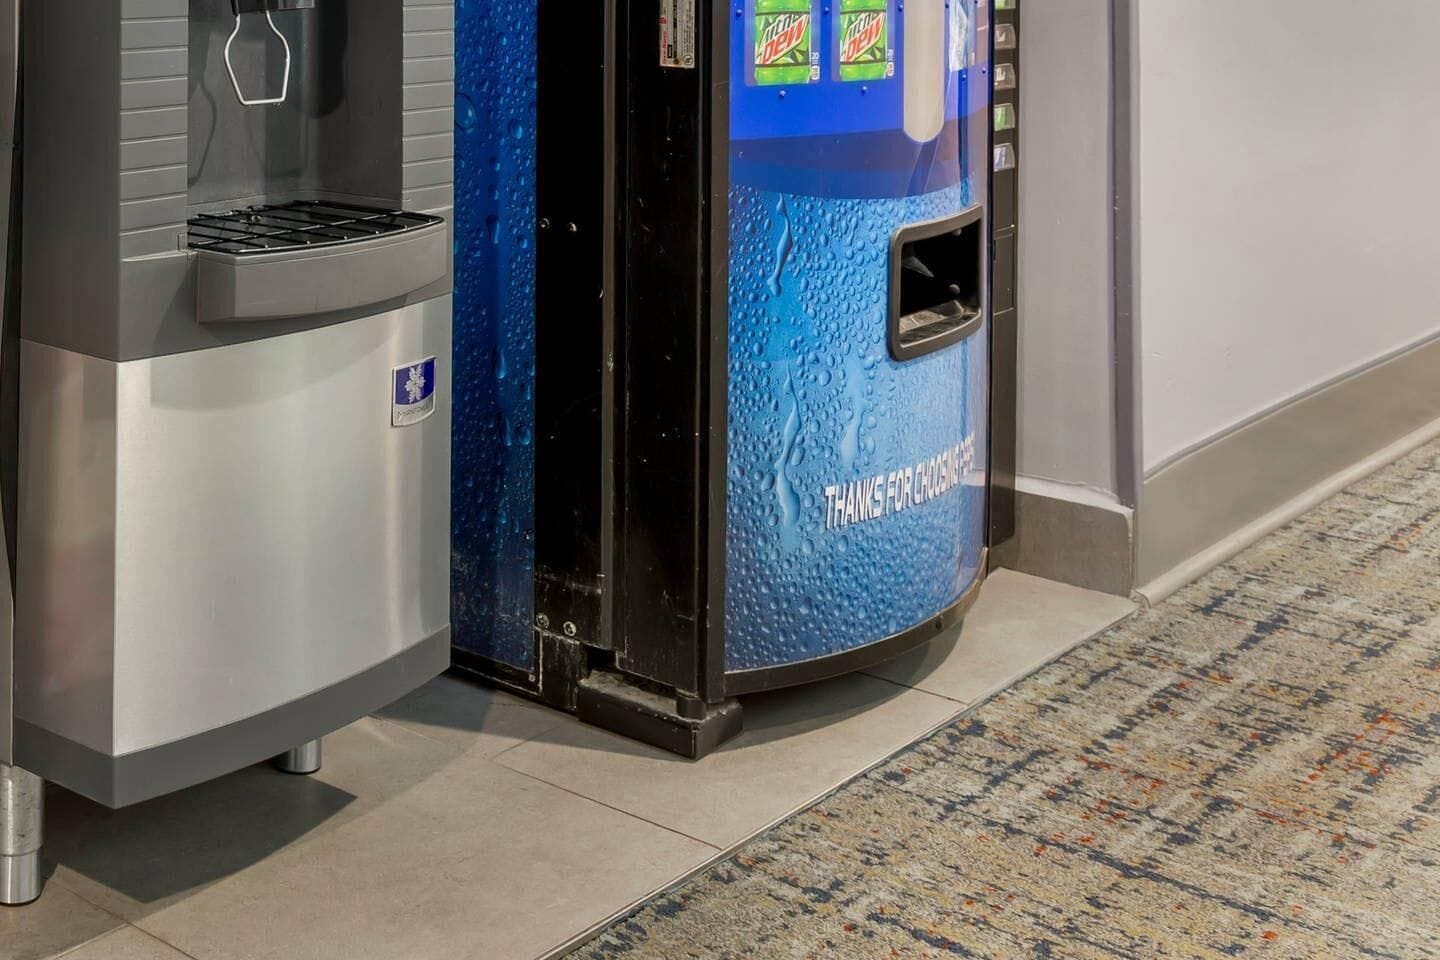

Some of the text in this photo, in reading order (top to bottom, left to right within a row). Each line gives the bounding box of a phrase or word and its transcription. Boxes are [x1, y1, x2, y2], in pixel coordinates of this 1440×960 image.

[825, 475, 884, 528] THANKS
[886, 467, 912, 515] FOR
[914, 446, 960, 506] CHOOSING
